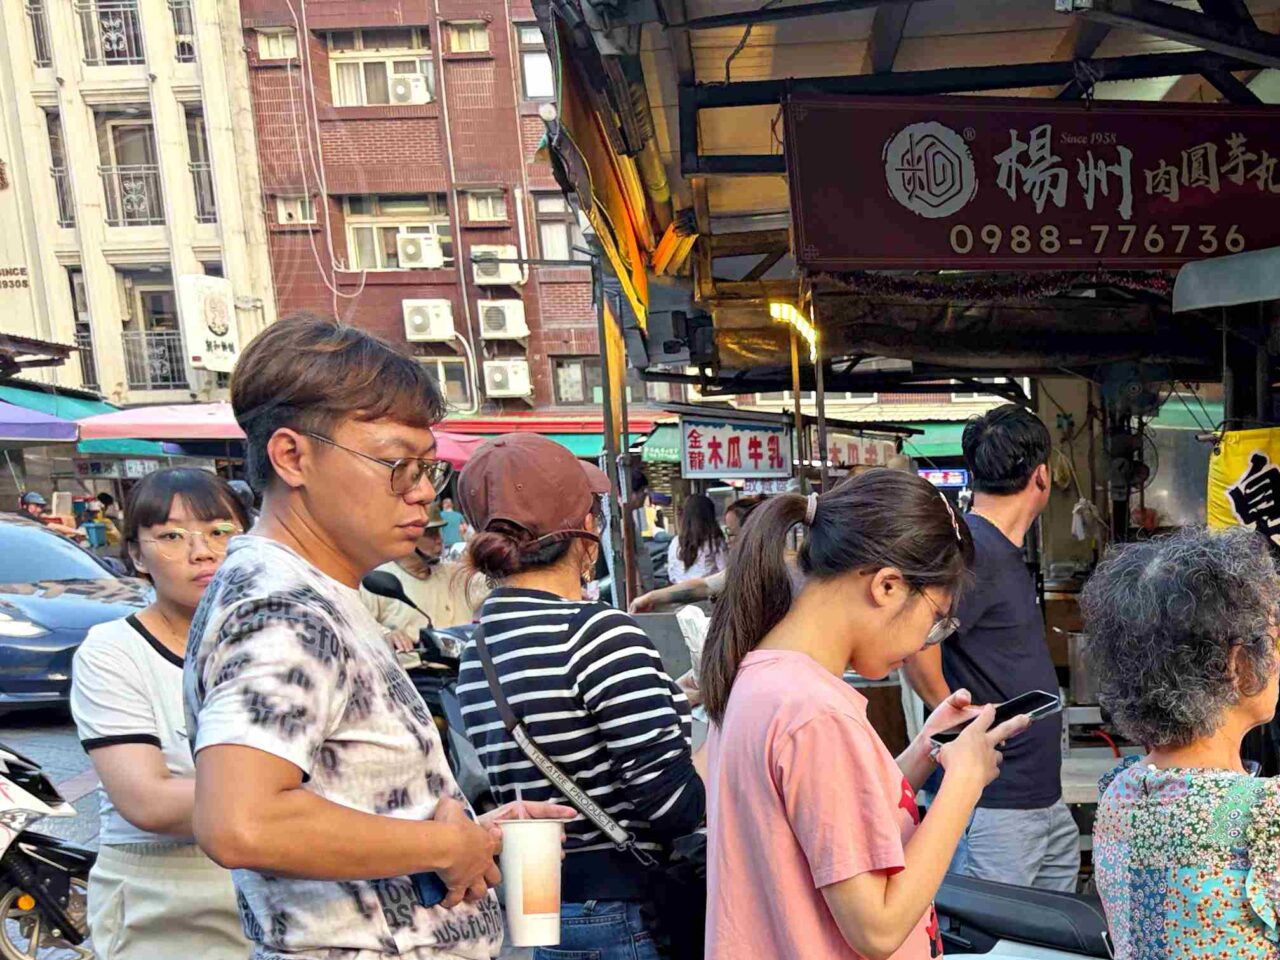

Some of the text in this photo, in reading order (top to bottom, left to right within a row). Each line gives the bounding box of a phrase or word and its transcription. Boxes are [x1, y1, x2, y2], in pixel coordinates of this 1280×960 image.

[1060, 131, 1088, 145] Since
[950, 224, 1246, 254] 0988-776736
[707, 434, 784, 470] 木瓜牛乳
[531, 749, 618, 832] THEATRE PRODUCTS
